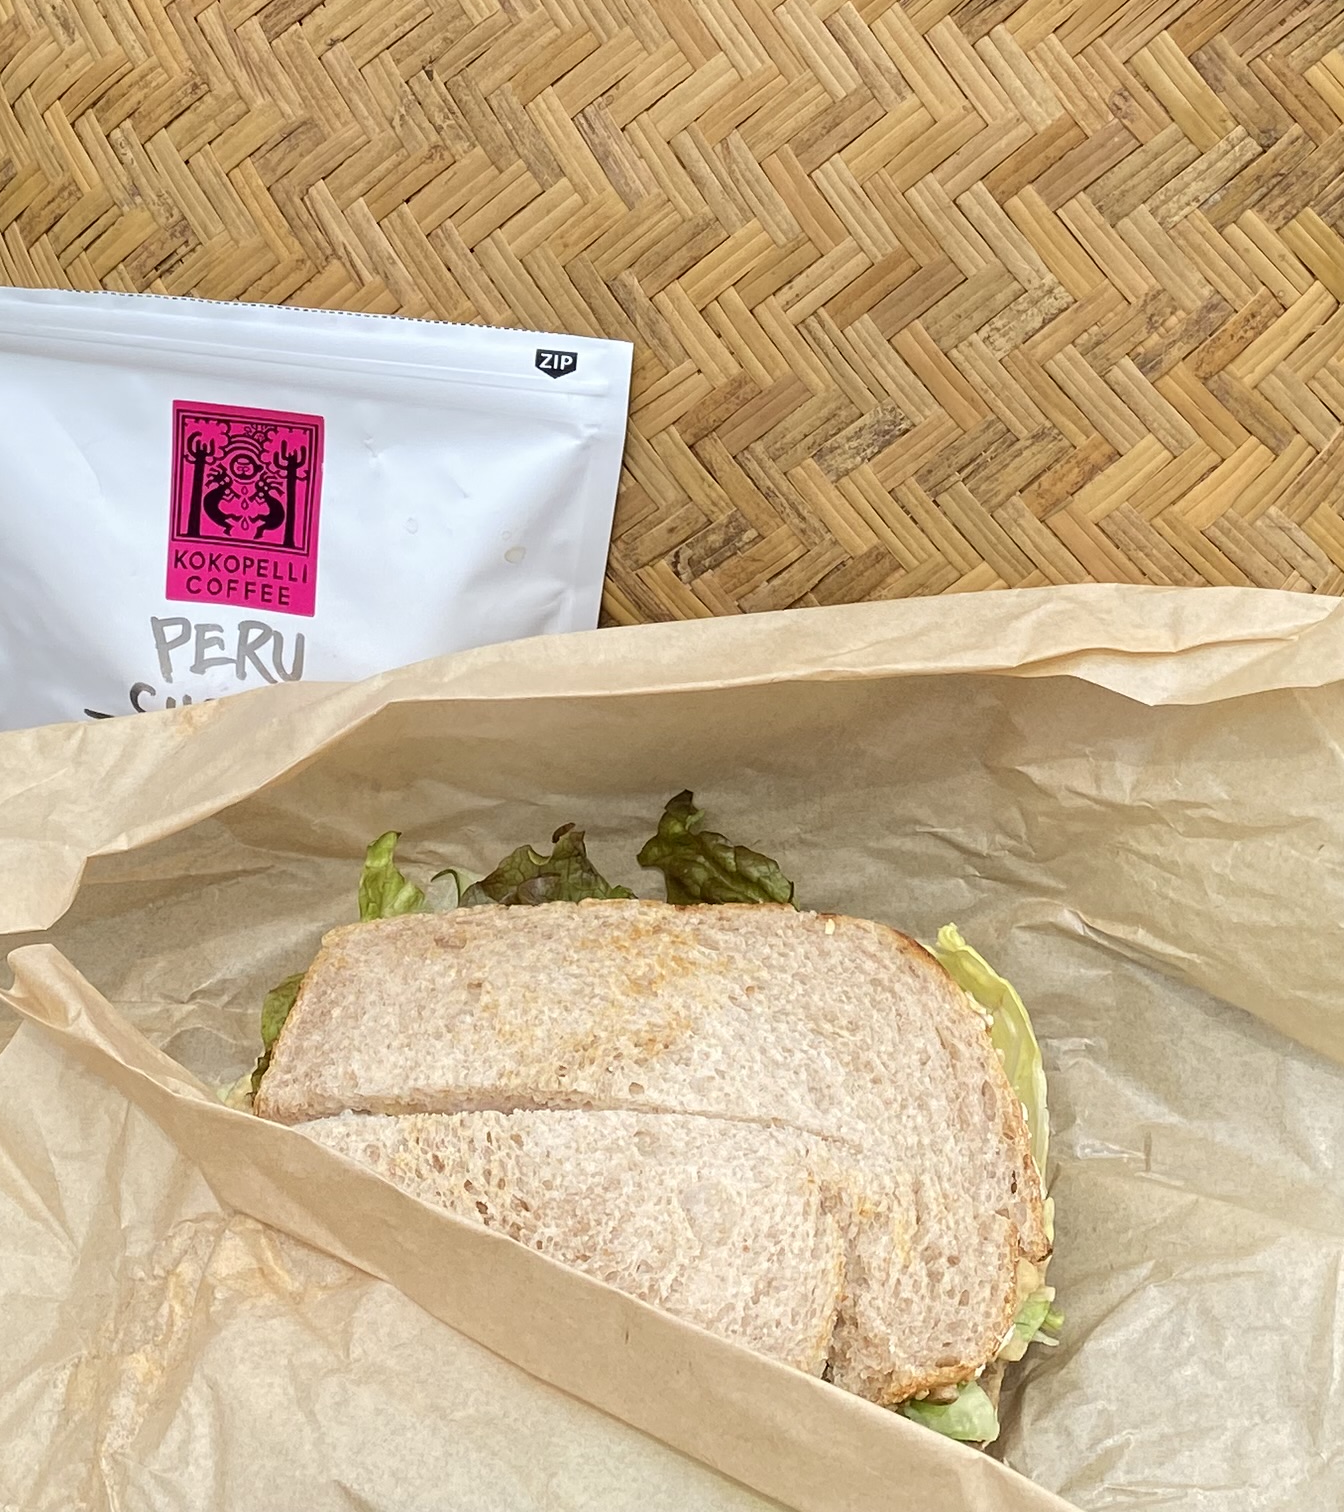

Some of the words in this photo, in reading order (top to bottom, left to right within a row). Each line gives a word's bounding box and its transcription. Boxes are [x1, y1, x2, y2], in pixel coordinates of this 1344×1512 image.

[539, 352, 573, 370] ZIP
[174, 549, 308, 584] KOKOPELLI
[186, 575, 291, 606] COFFEE
[150, 616, 306, 684] PERU
